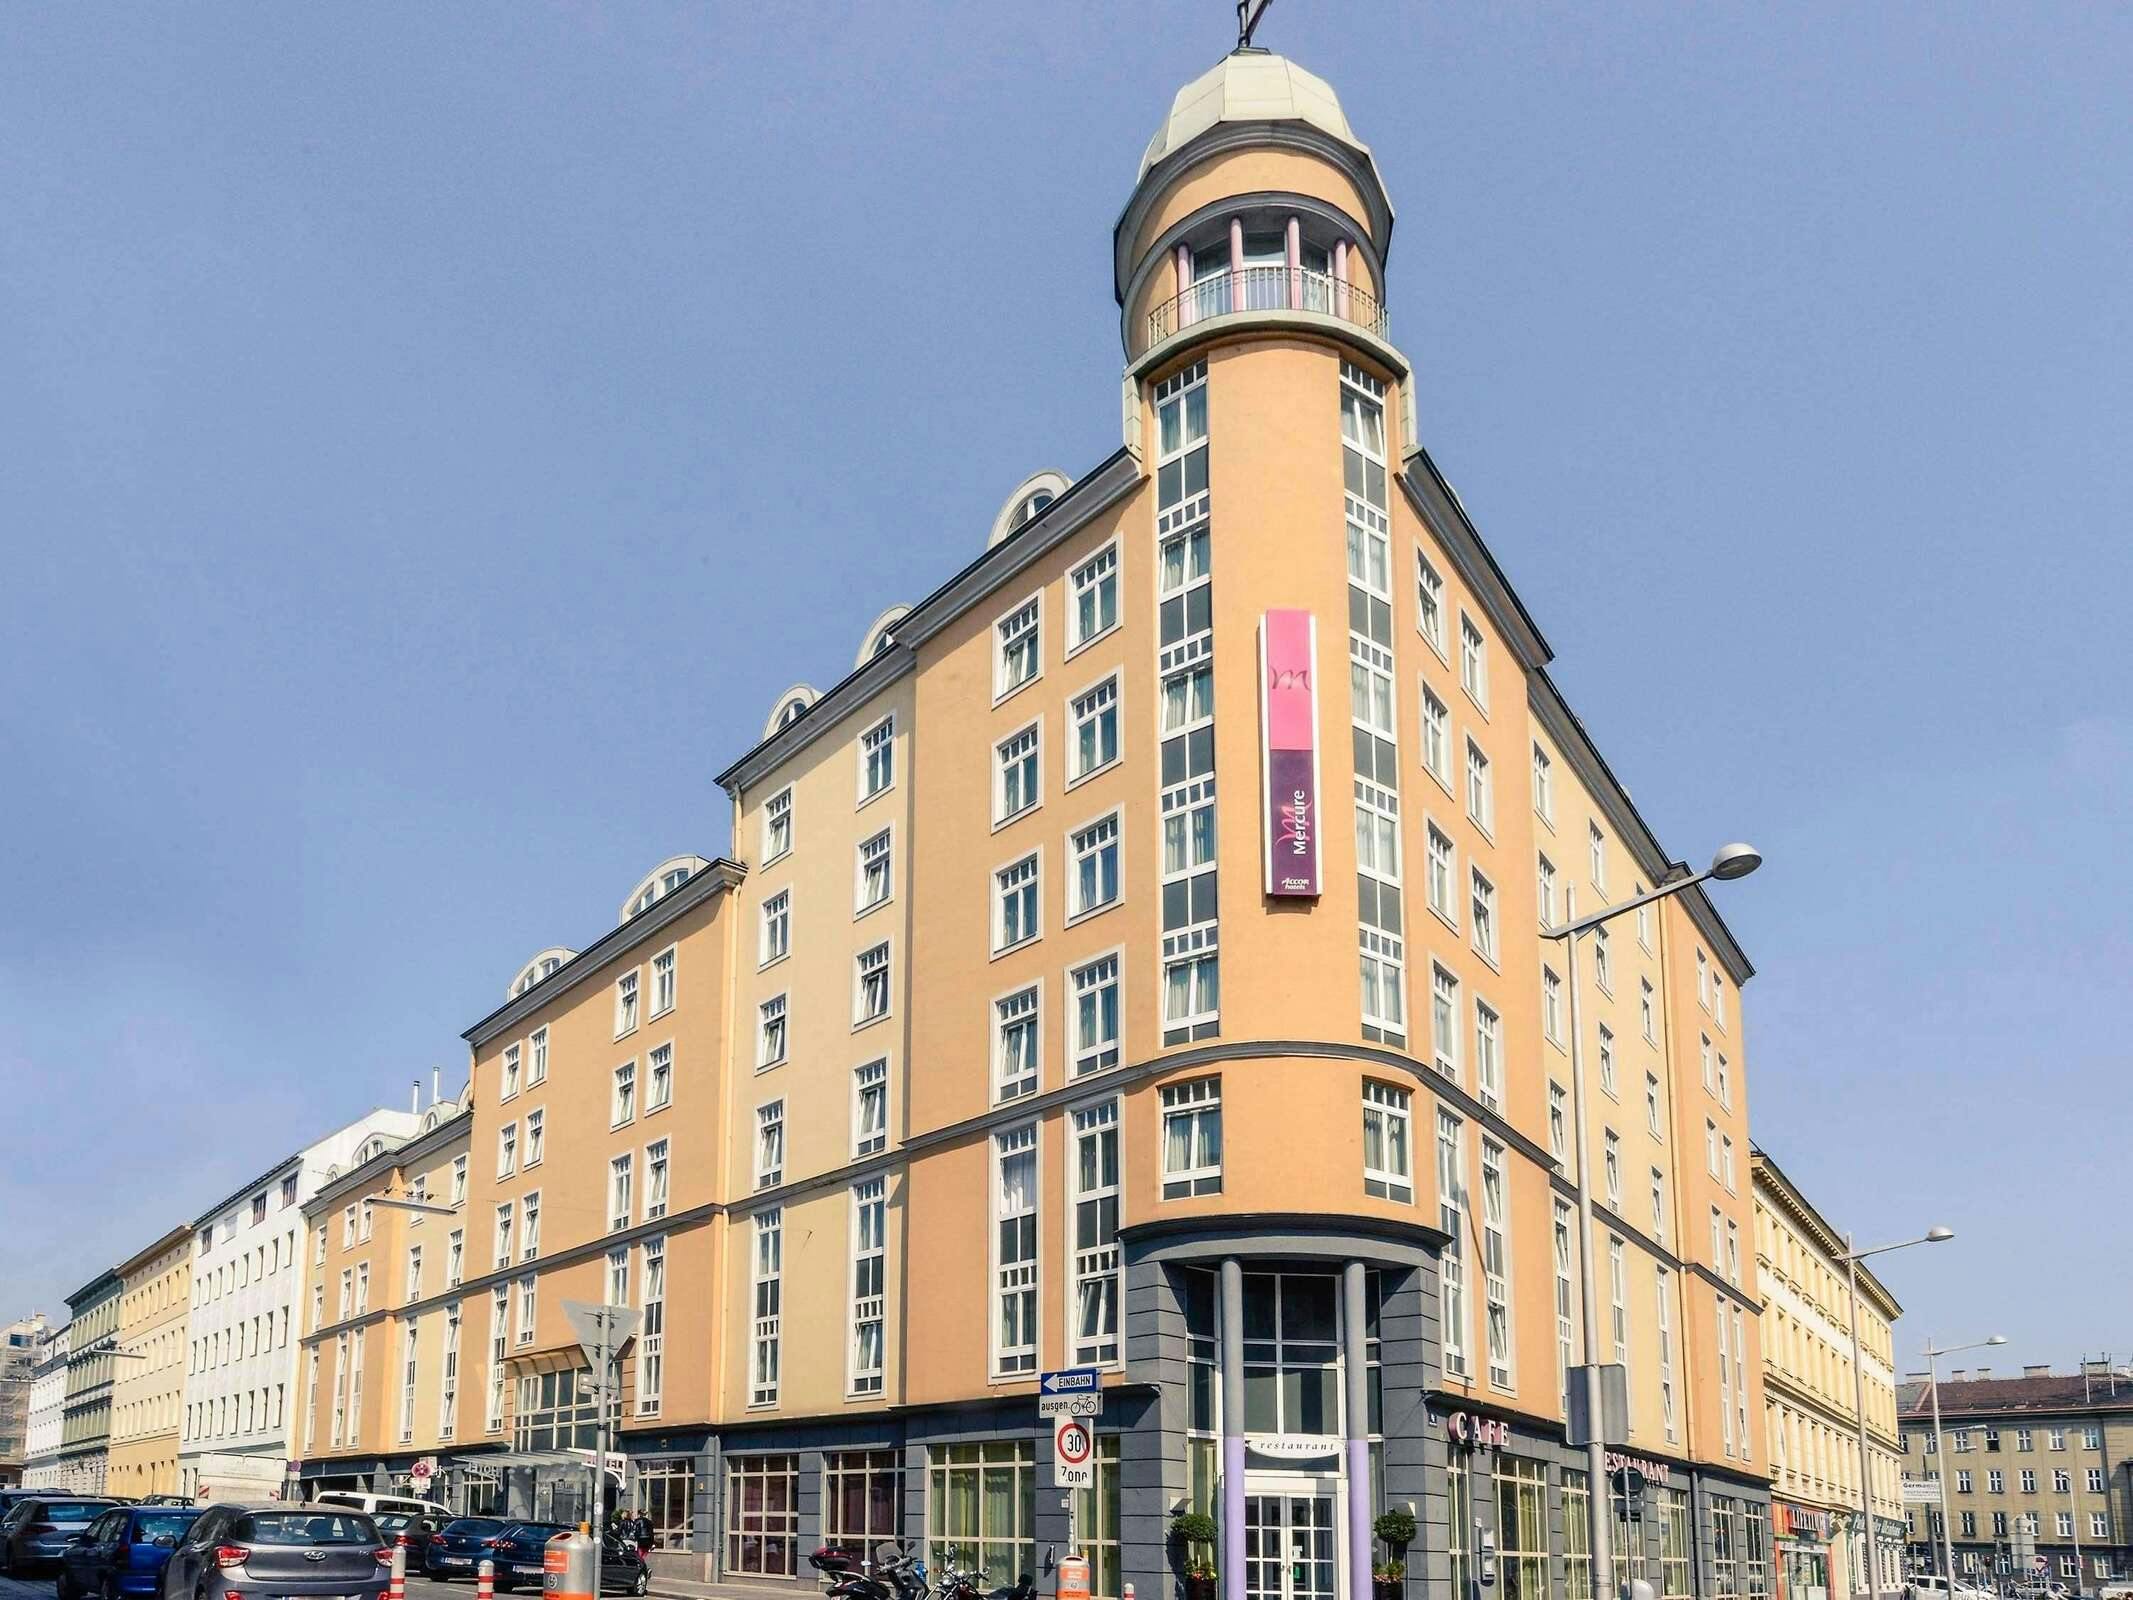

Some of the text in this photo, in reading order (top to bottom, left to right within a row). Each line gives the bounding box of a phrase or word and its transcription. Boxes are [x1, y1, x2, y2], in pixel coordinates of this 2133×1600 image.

[1294, 790, 1306, 855] Mercure
[1058, 1376, 1091, 1388] EINBAHN
[1067, 1434, 1081, 1452] 30
[1260, 1442, 1334, 1451] restaurant
[1603, 1451, 1669, 1482] ESTAURANT
